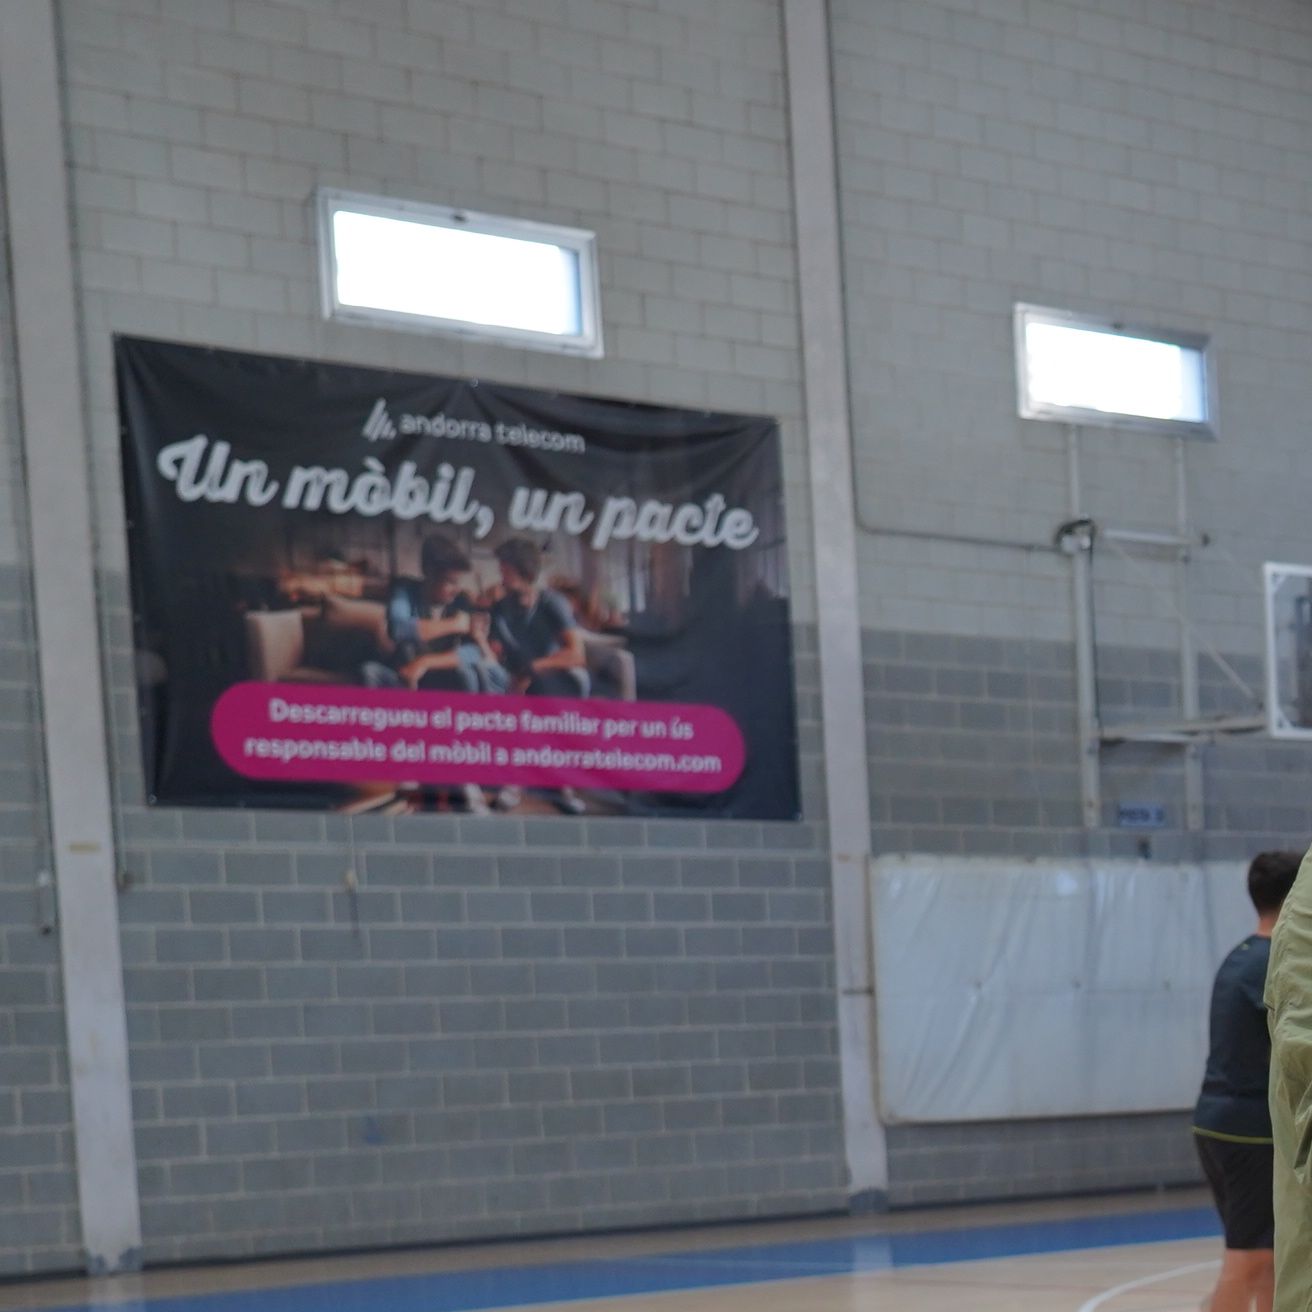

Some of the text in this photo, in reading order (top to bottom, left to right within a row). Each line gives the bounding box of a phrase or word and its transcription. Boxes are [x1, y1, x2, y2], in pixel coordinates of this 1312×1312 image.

[401, 411, 586, 455] andorra telecom
[157, 434, 279, 505] Un
[508, 486, 596, 537] un
[592, 493, 760, 551] pacte
[268, 697, 428, 731] Descarregueu
[431, 706, 452, 729] el
[455, 709, 517, 734] pacte
[520, 710, 599, 736] familiar
[603, 718, 637, 741] per
[640, 720, 667, 737] un
[244, 736, 722, 773] responsable del mòbil a andorratelecom.com
